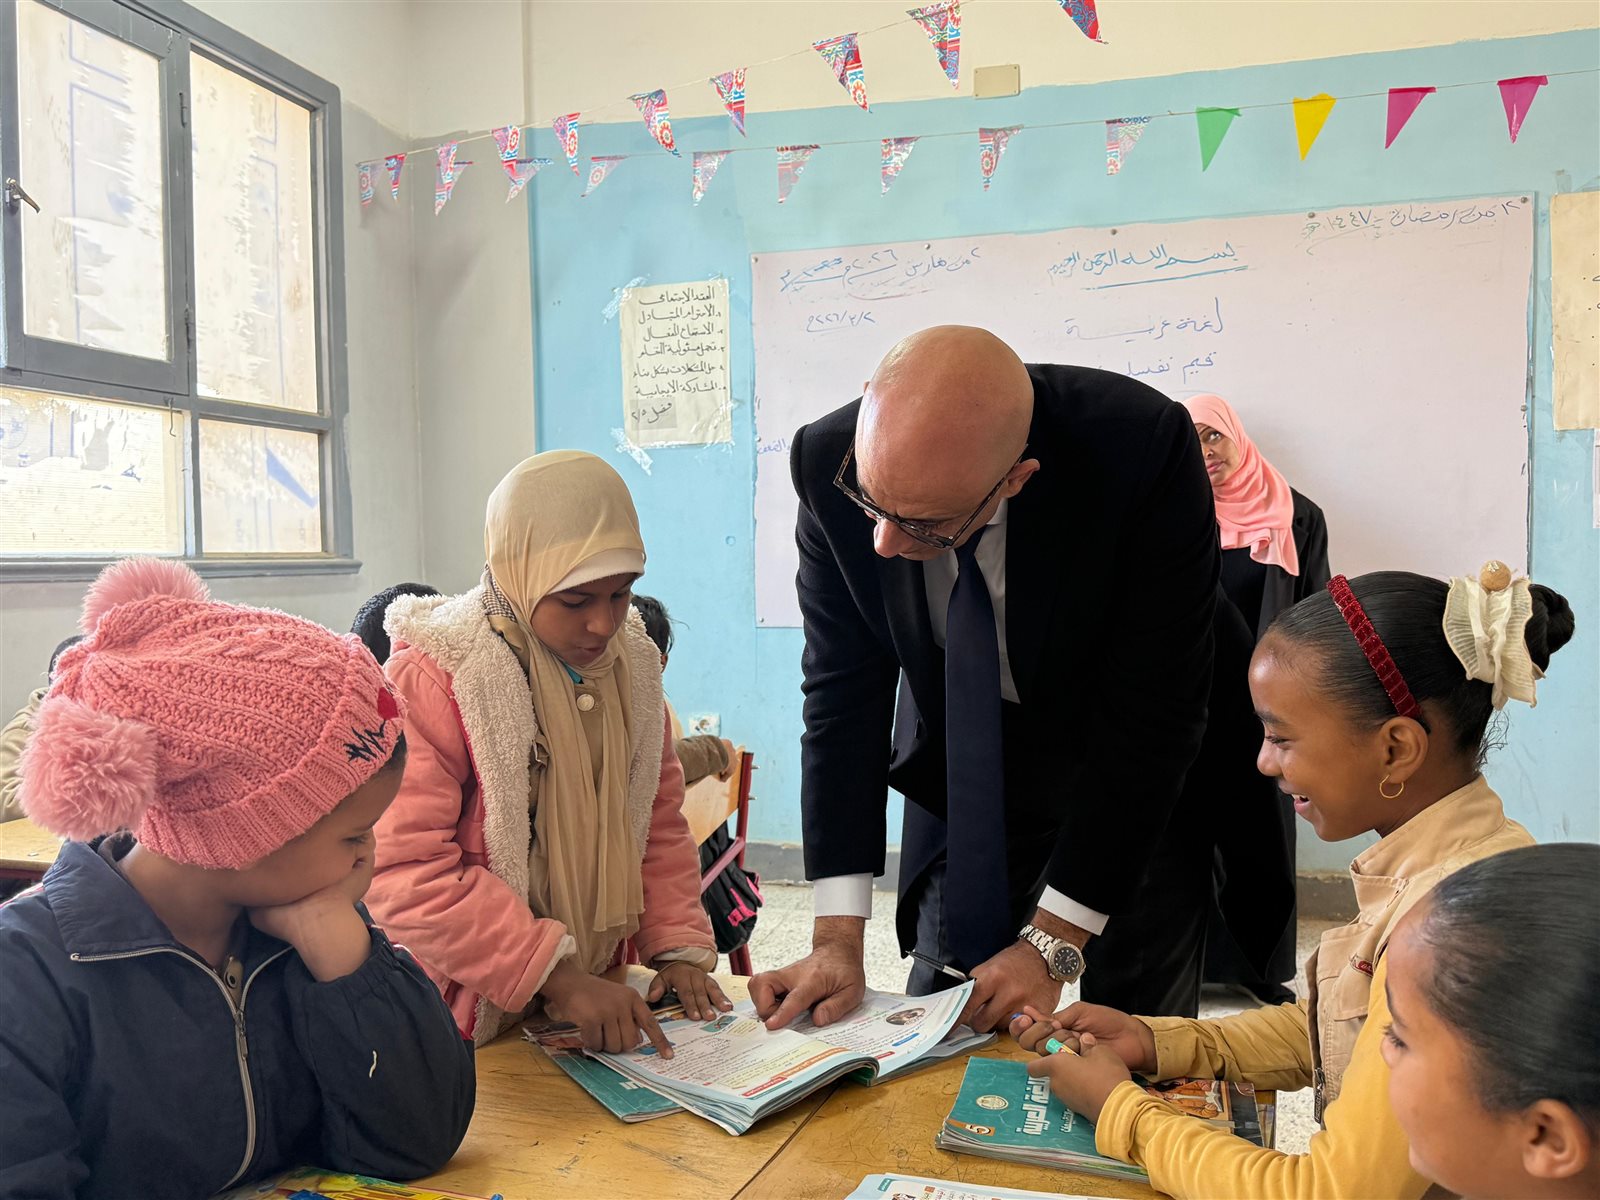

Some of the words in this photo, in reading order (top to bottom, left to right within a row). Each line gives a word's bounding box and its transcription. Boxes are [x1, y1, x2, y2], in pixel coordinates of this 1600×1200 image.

[1390, 204, 1458, 230] رمضان
[1082, 248, 1119, 275] الرحمن
[1121, 243, 1168, 265] الله
[1154, 241, 1239, 270] بسم
[1048, 251, 1080, 282] الرحيم
[693, 285, 715, 301] العقد
[638, 306, 683, 325] المتبادل
[683, 303, 715, 320] الاحترام
[1176, 297, 1224, 334] لغة
[643, 323, 680, 342] الفعال
[680, 322, 714, 339] الاستماع
[1064, 318, 1171, 344] عربية
[638, 342, 665, 358] التعلم
[697, 342, 717, 356] تحمل
[651, 364, 670, 378] بشكل
[670, 361, 706, 375] المشكلات
[680, 376, 718, 394] المشاركة
[966, 1121, 991, 1135] 5
[1016, 1103, 1051, 1135] العربية
